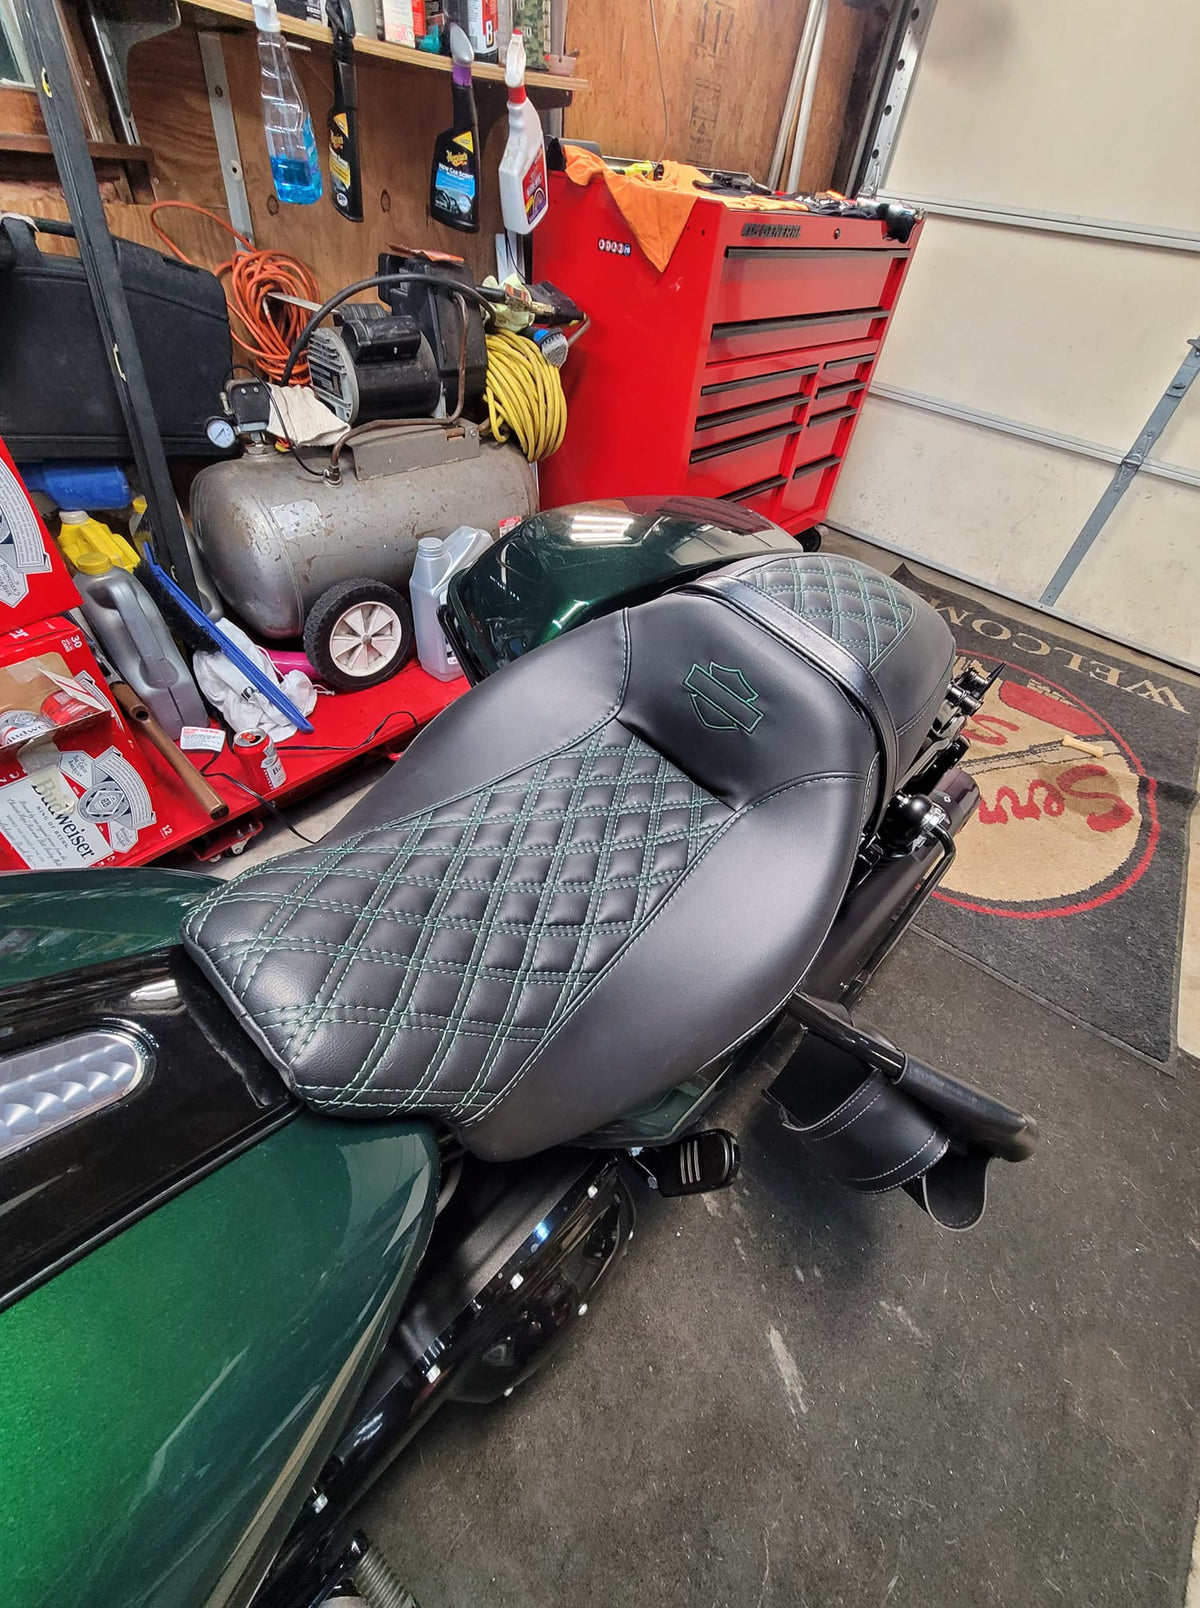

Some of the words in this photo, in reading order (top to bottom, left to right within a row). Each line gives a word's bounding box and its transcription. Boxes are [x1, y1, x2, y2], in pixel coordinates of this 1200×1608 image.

[70, 635, 83, 649] 30
[922, 595, 1190, 714] WELCOM
[31, 776, 95, 860] Budweiser
[161, 824, 173, 837] 12
